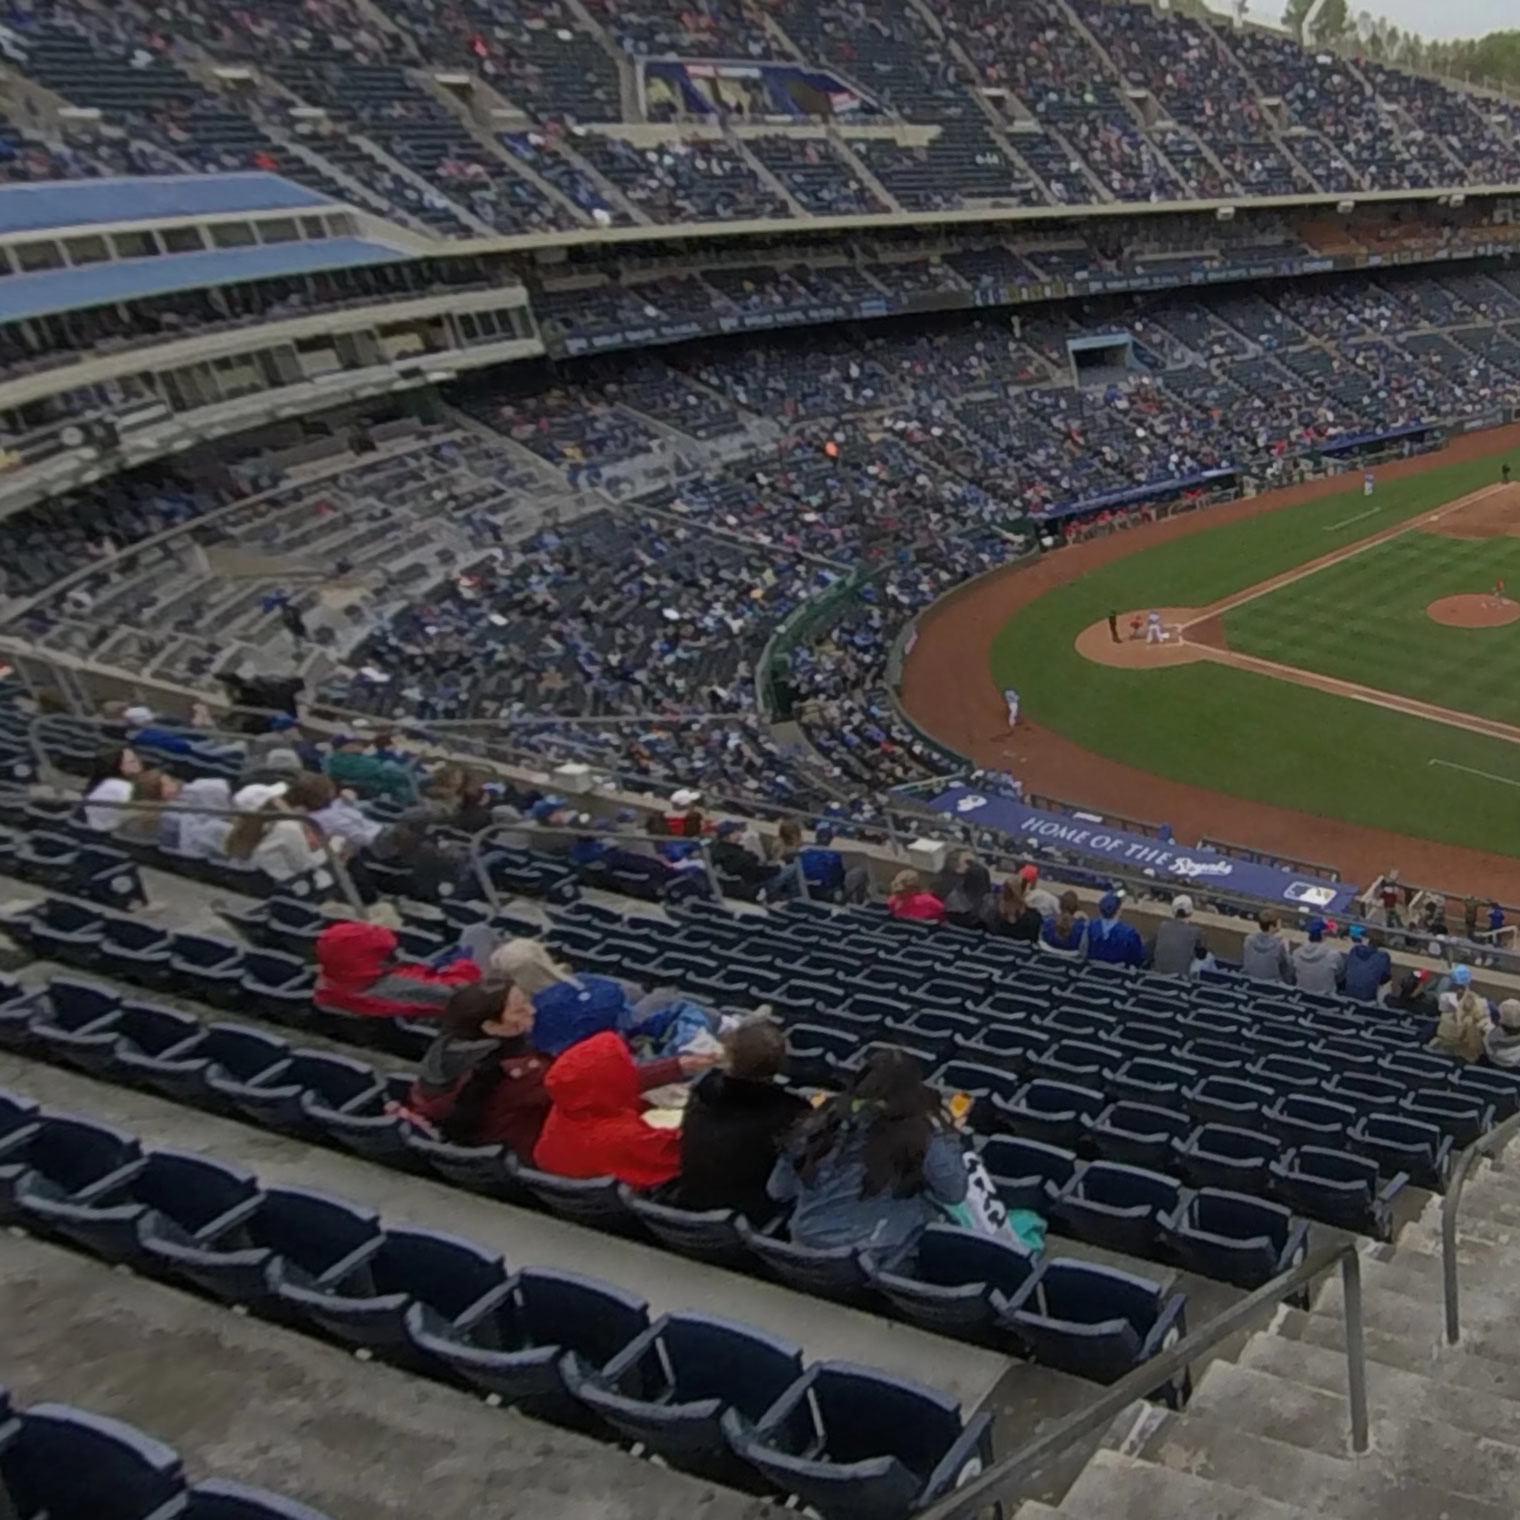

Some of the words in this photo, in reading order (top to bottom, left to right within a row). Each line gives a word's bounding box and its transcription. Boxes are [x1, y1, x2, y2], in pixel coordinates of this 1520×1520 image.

[1021, 817, 1089, 844] HOME
[1091, 834, 1123, 852] OF
[1125, 843, 1170, 864] THE
[1168, 857, 1233, 877] Royals
